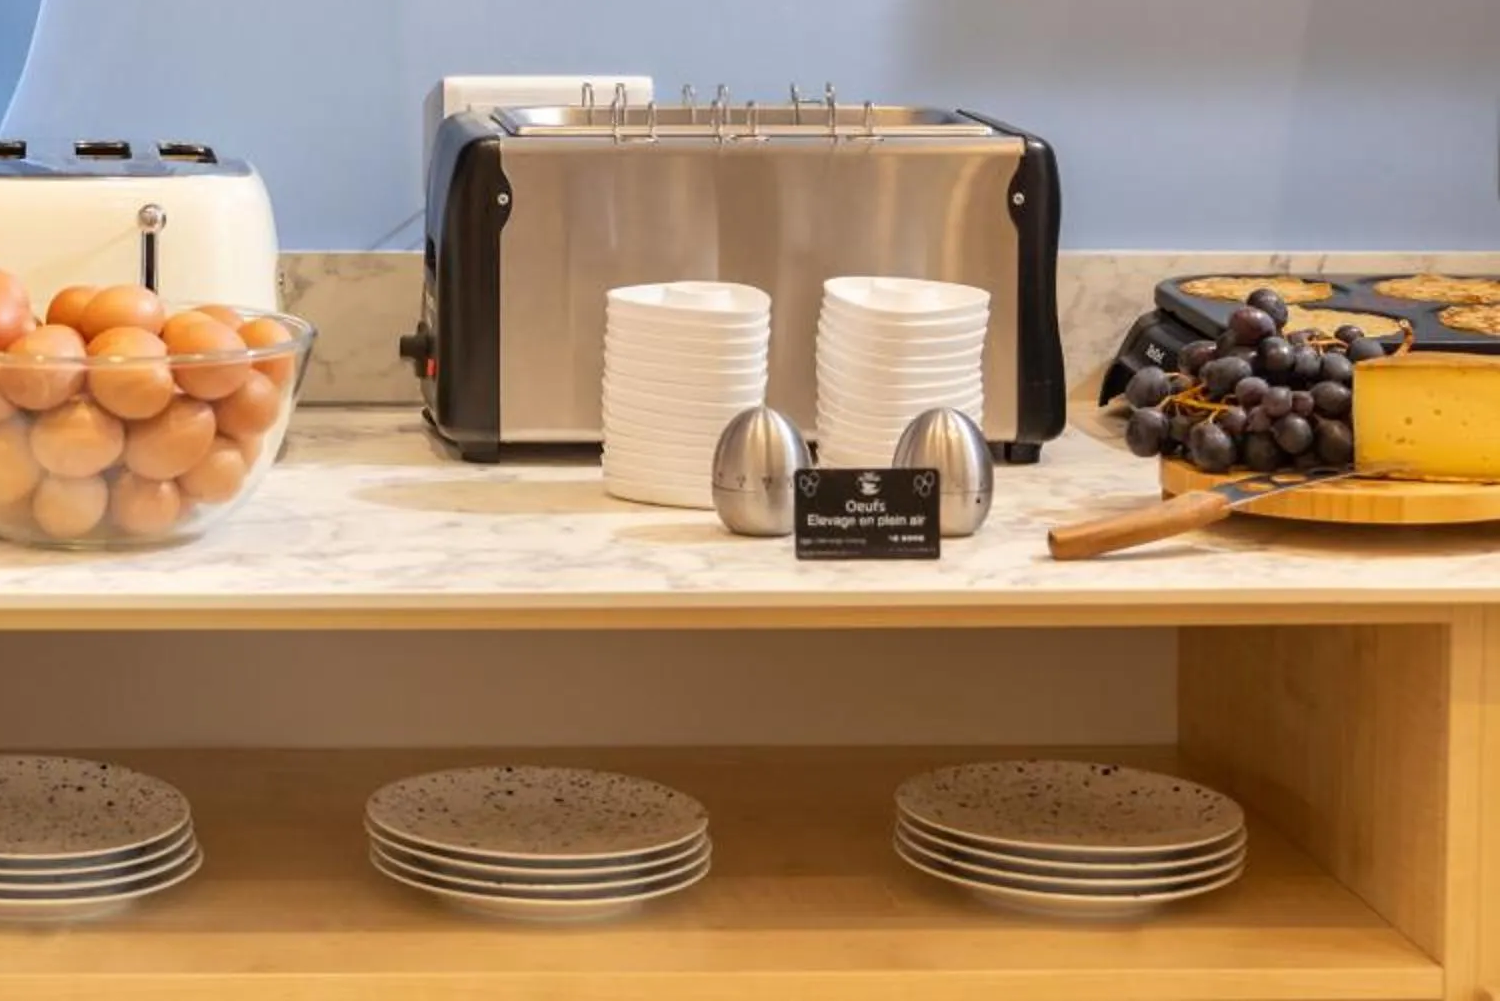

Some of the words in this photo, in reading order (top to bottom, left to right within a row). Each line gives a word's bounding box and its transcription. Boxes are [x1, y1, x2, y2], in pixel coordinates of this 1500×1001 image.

[845, 499, 887, 512] Oeufs
[807, 513, 857, 530] Elevage
[859, 516, 875, 527] en
[877, 513, 907, 528] plein
[909, 513, 927, 527] air
